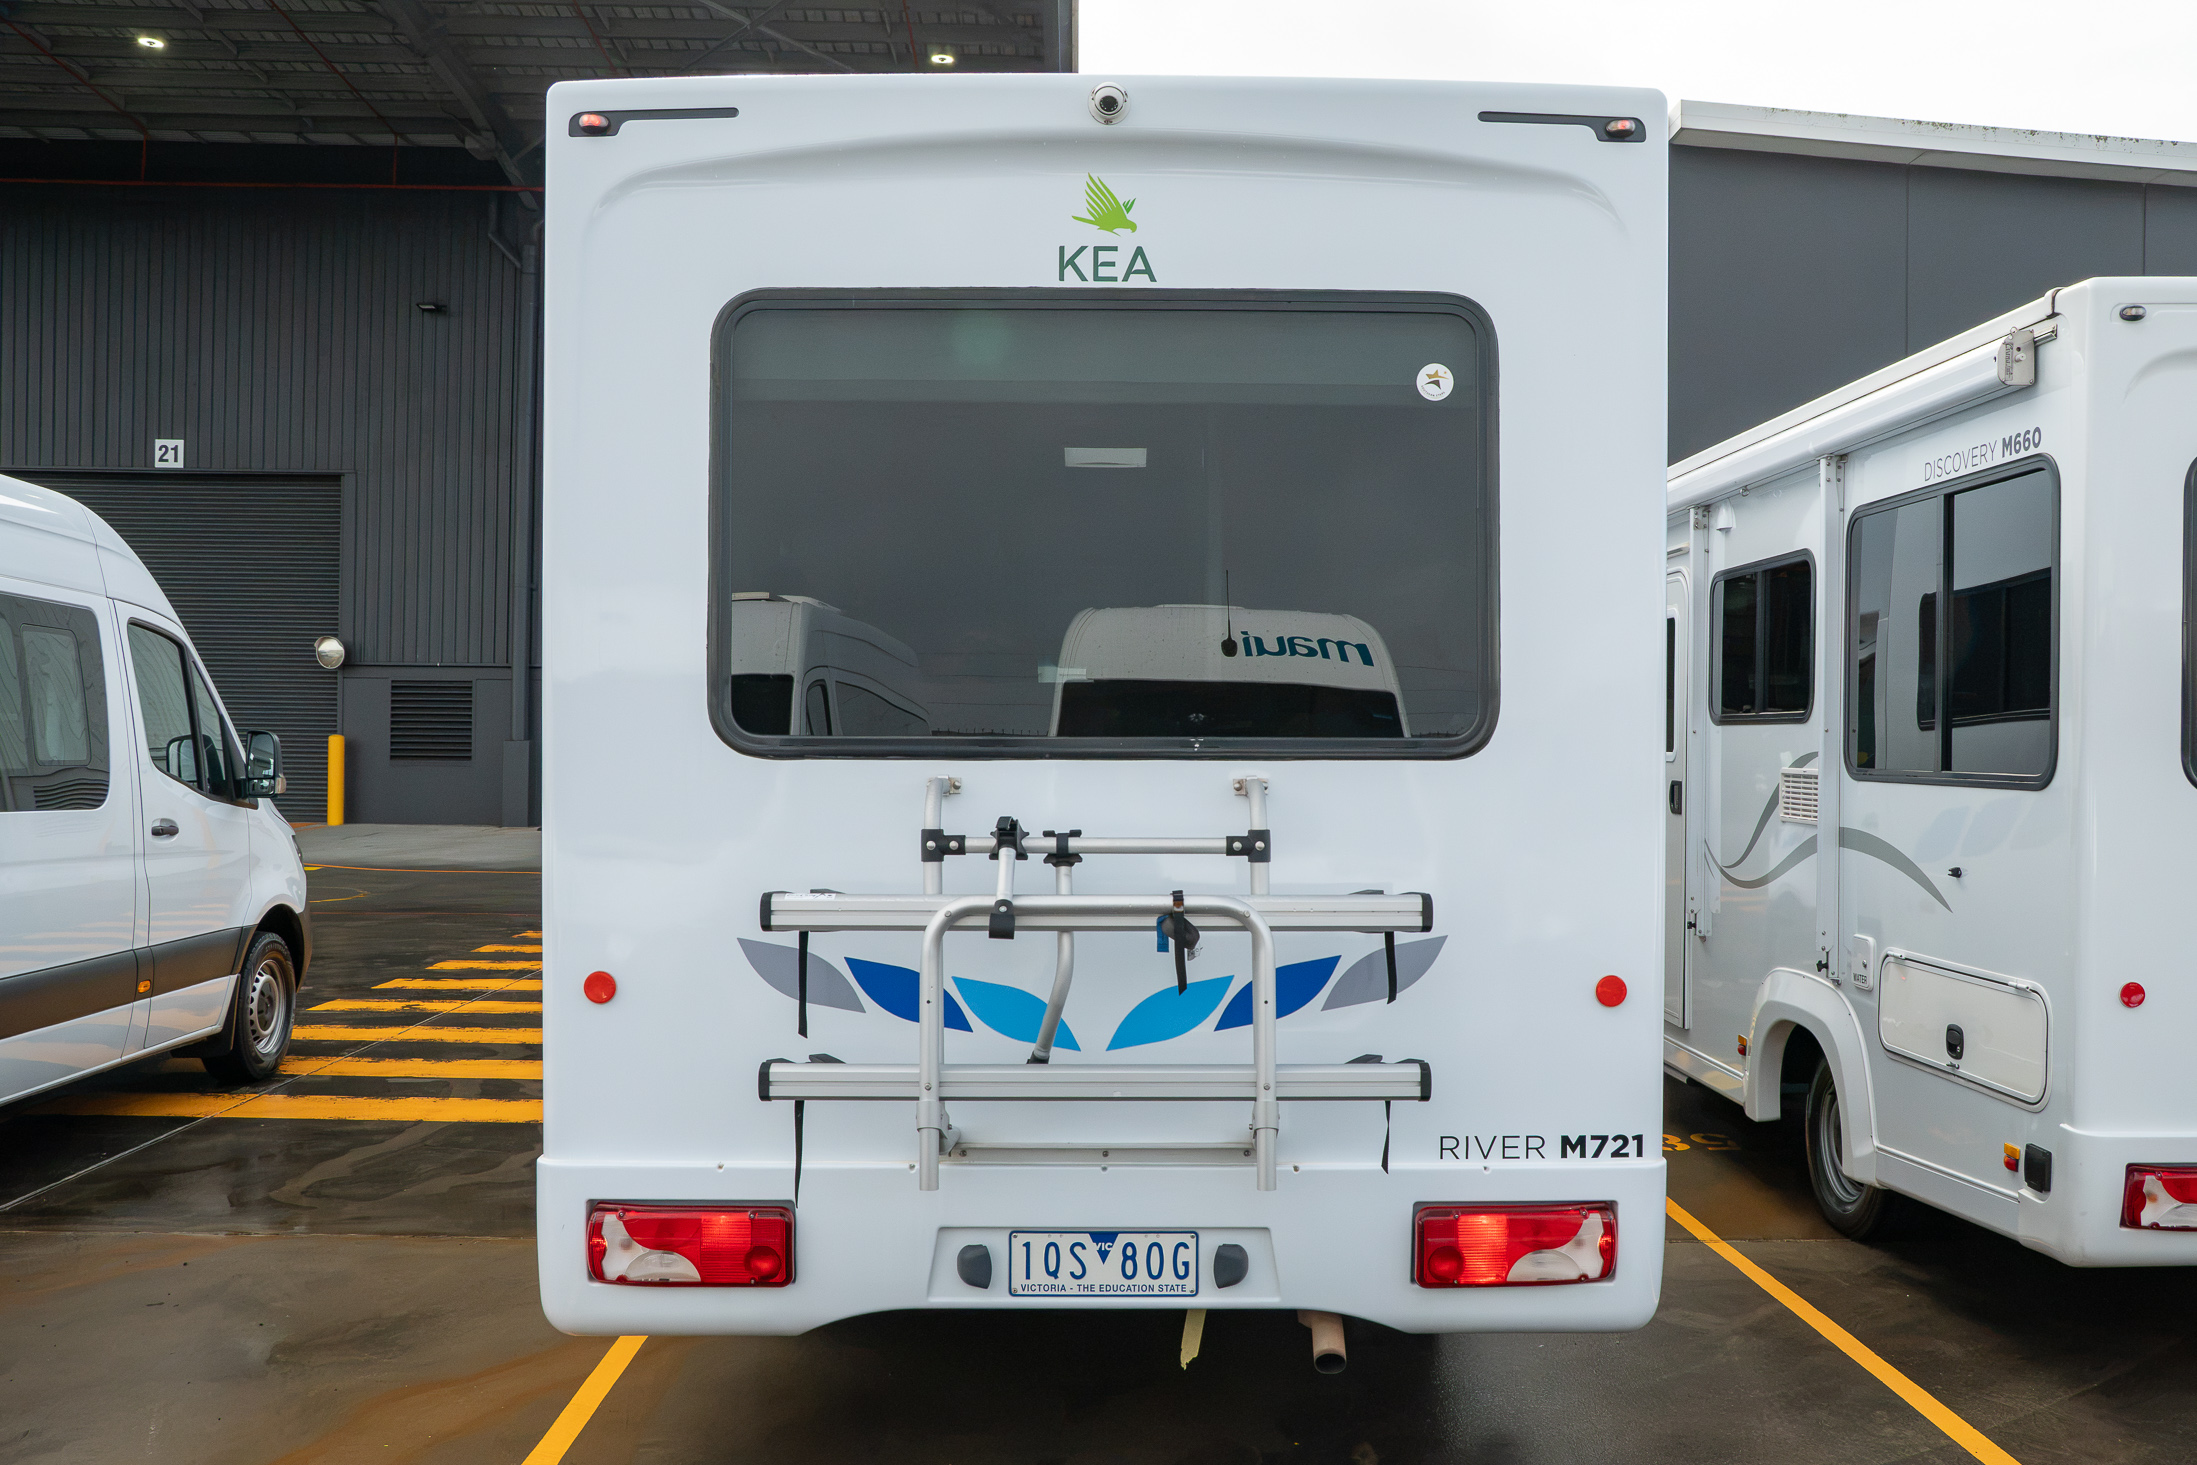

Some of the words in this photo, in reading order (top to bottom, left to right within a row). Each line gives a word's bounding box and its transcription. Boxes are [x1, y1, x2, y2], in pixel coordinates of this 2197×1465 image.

[1058, 245, 1158, 283] KEA
[157, 444, 179, 463] 21
[1924, 439, 1998, 482] DISCOVERY
[2002, 426, 2041, 458] M660
[1439, 1135, 1546, 1160] RIVER
[1560, 1133, 1644, 1159] M721
[1094, 1242, 1113, 1251] VIC
[1022, 1241, 1087, 1281] 1QS
[1020, 1283, 1067, 1293] VICTORIA
[1077, 1283, 1096, 1293] THE
[1099, 1283, 1156, 1293] EDUCATION
[1158, 1283, 1187, 1293] STATE
